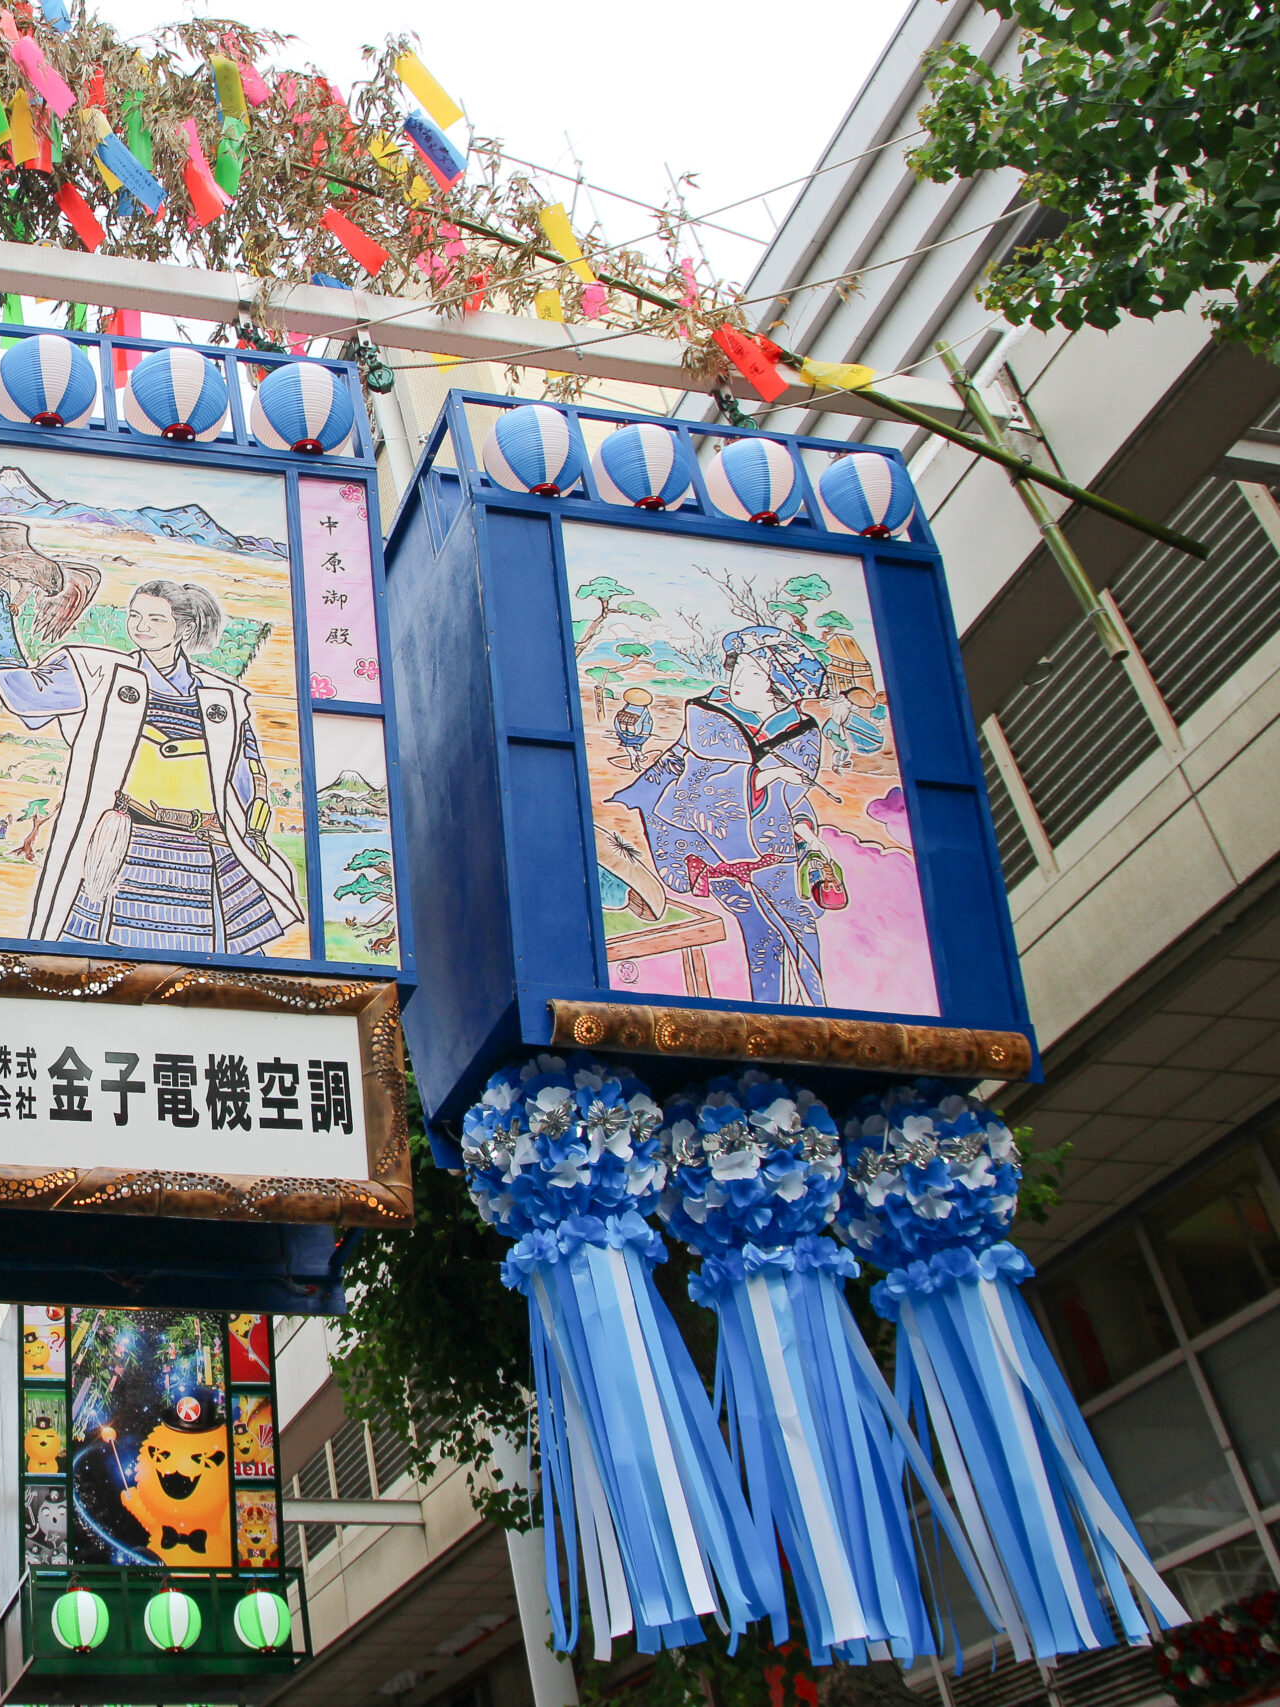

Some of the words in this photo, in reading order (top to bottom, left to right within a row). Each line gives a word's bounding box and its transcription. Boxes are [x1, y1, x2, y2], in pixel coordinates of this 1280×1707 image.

[319, 515, 353, 647] 中原御殿
[47, 1045, 355, 1136] 金子電機空調
